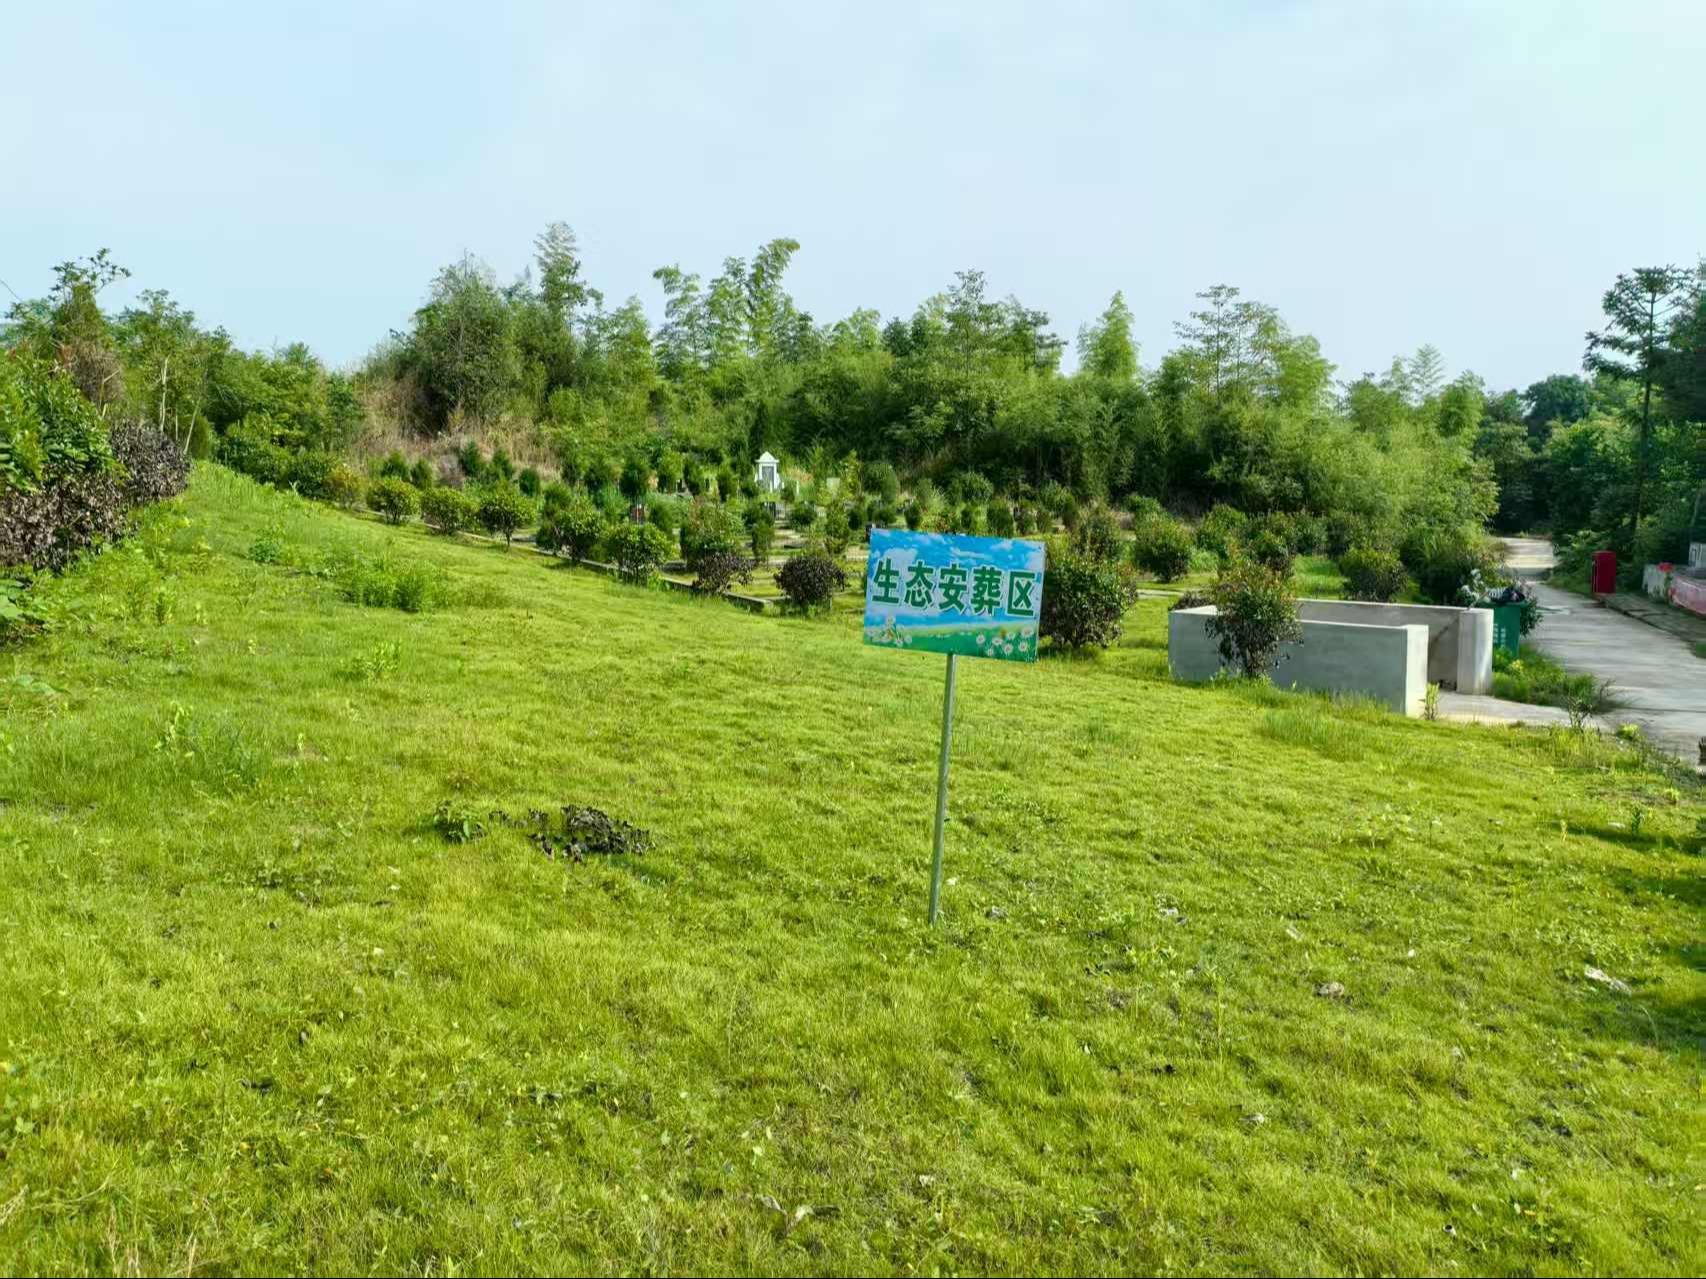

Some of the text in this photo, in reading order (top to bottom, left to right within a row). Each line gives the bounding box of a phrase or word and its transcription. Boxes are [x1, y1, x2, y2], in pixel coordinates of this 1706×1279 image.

[872, 557, 1036, 616] 生态安葬区
